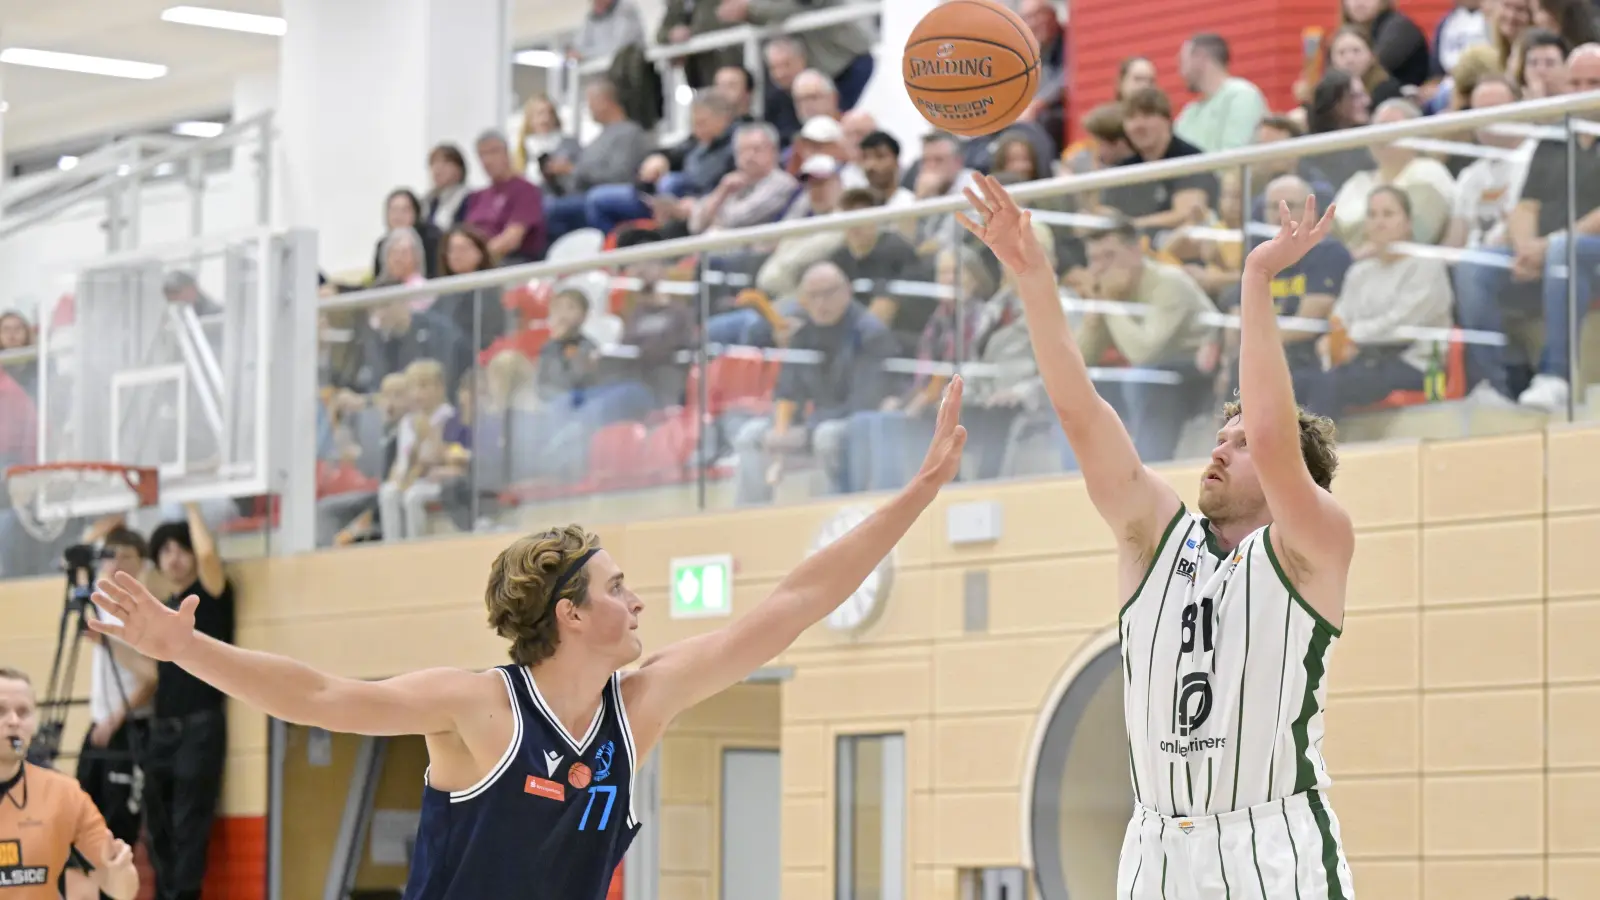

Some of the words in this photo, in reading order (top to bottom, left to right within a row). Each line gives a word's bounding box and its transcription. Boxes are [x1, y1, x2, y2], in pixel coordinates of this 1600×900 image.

[909, 56, 993, 79] SPALDING
[917, 96, 994, 114] PRECISION
[1181, 597, 1214, 653] 81
[578, 785, 617, 830] 77
[0, 868, 46, 885] LSIDE
